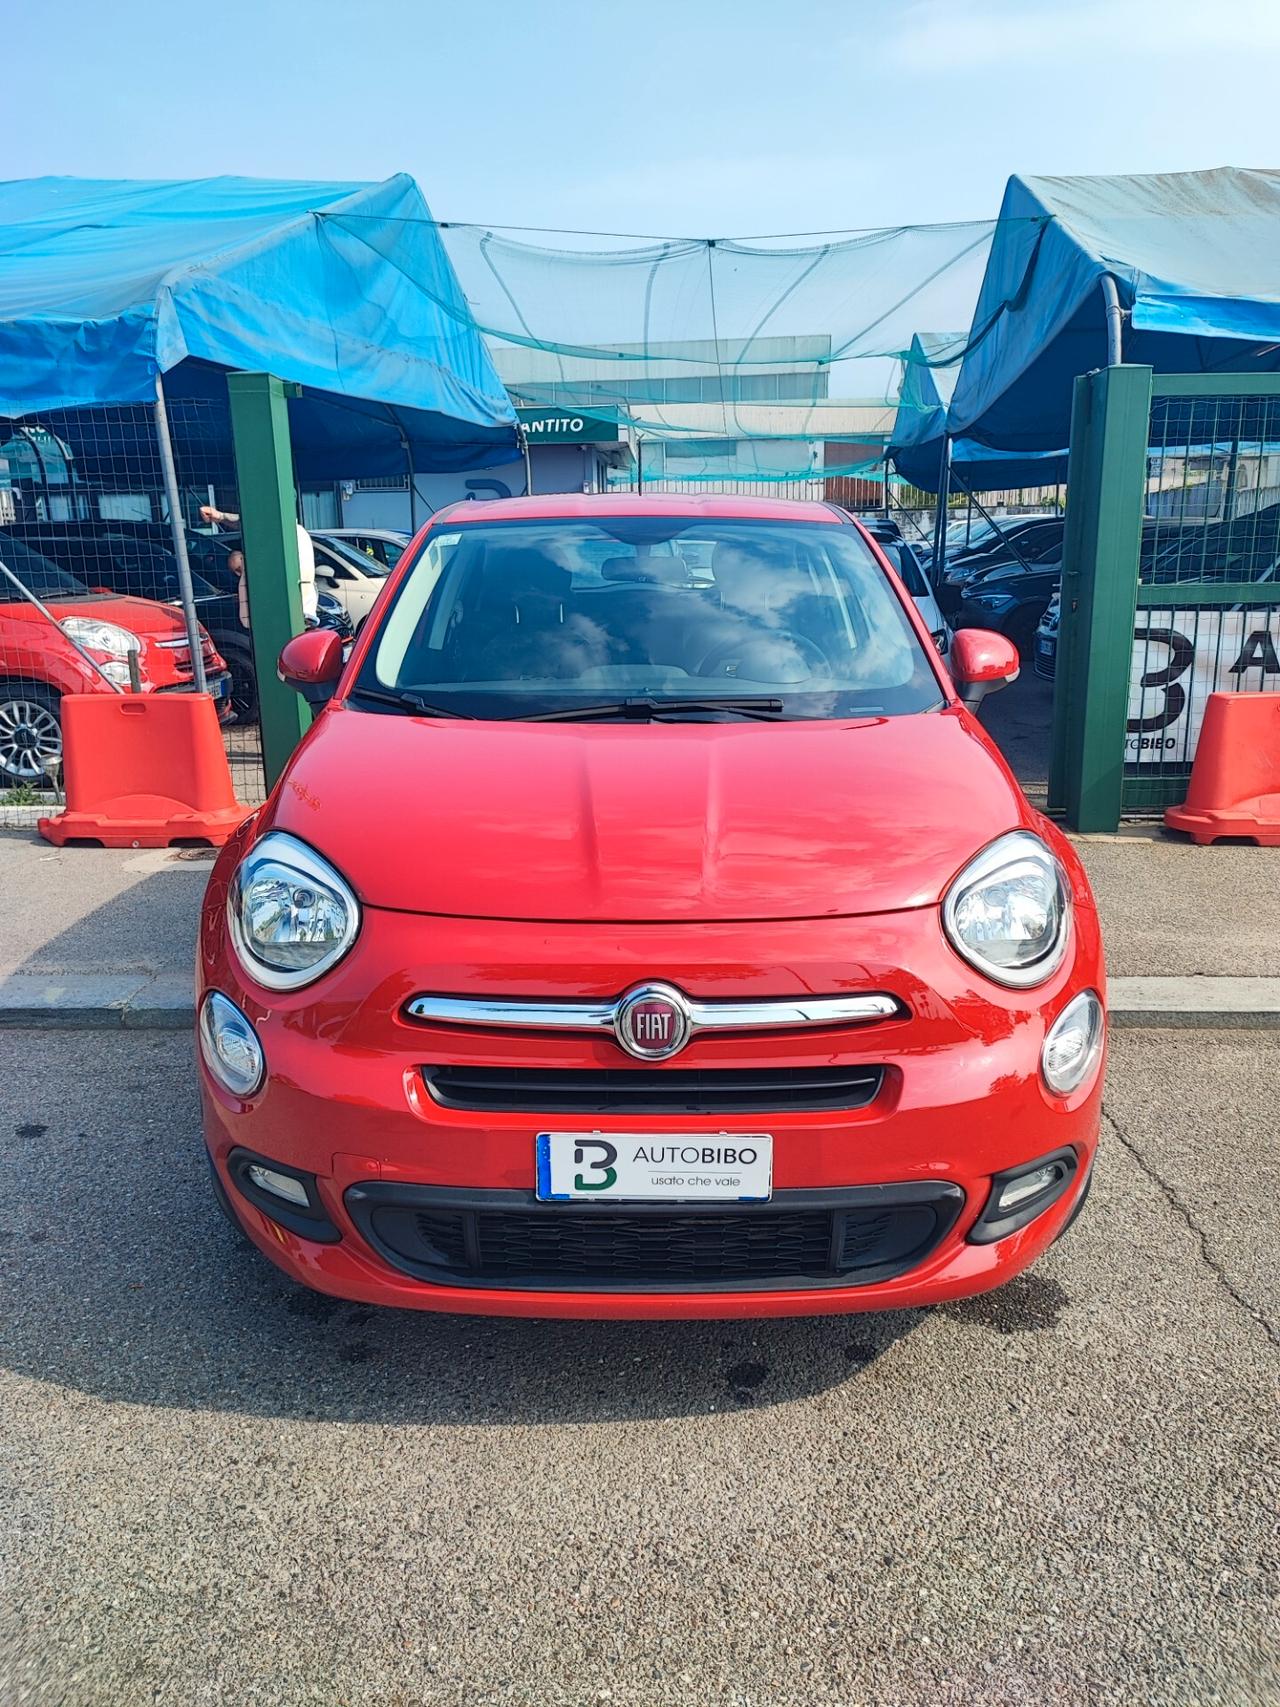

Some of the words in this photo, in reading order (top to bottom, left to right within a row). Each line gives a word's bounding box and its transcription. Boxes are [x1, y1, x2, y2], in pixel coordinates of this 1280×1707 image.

[637, 1013, 671, 1040] FIAT
[632, 1146, 758, 1165] AUTOBIBO
[651, 1176, 685, 1186] usato
[687, 1176, 712, 1186] che
[715, 1176, 741, 1187] vale
